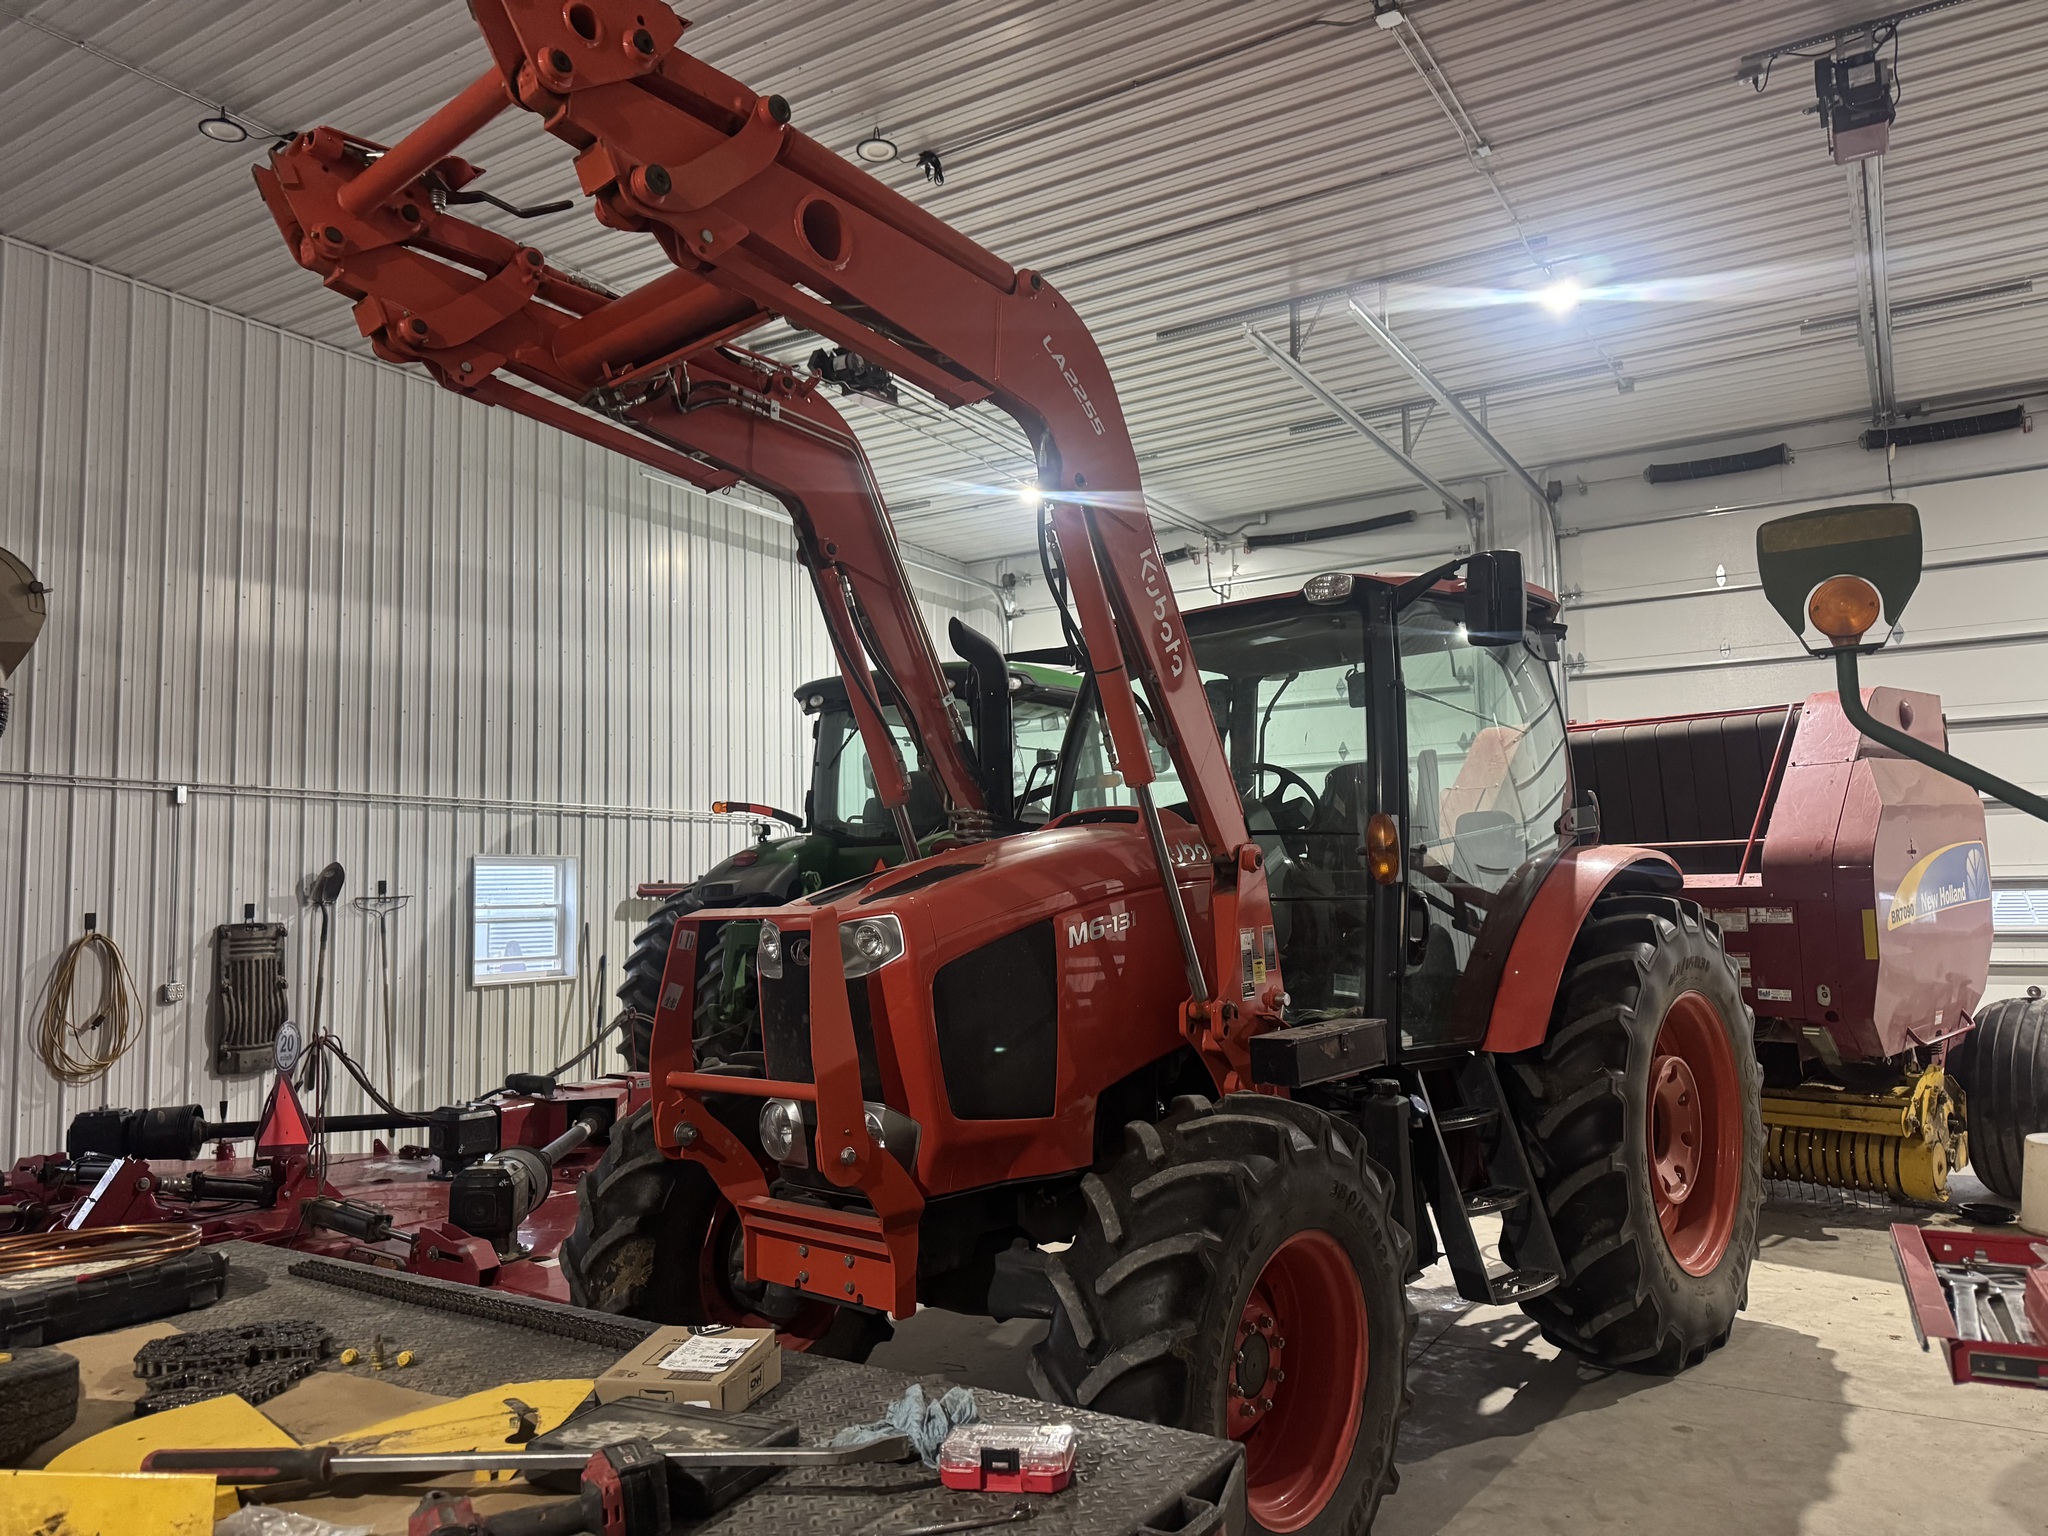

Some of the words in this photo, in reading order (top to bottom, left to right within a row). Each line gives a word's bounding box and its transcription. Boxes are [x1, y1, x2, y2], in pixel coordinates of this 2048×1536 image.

[1042, 334, 1106, 436] LA2255
[1139, 547, 1184, 678] Kubota
[1890, 903, 1915, 924] BR7090
[1920, 891, 1938, 913] New
[1939, 881, 1967, 907] Holland
[1068, 910, 1137, 949] M6-131
[280, 1034, 294, 1053] 20
